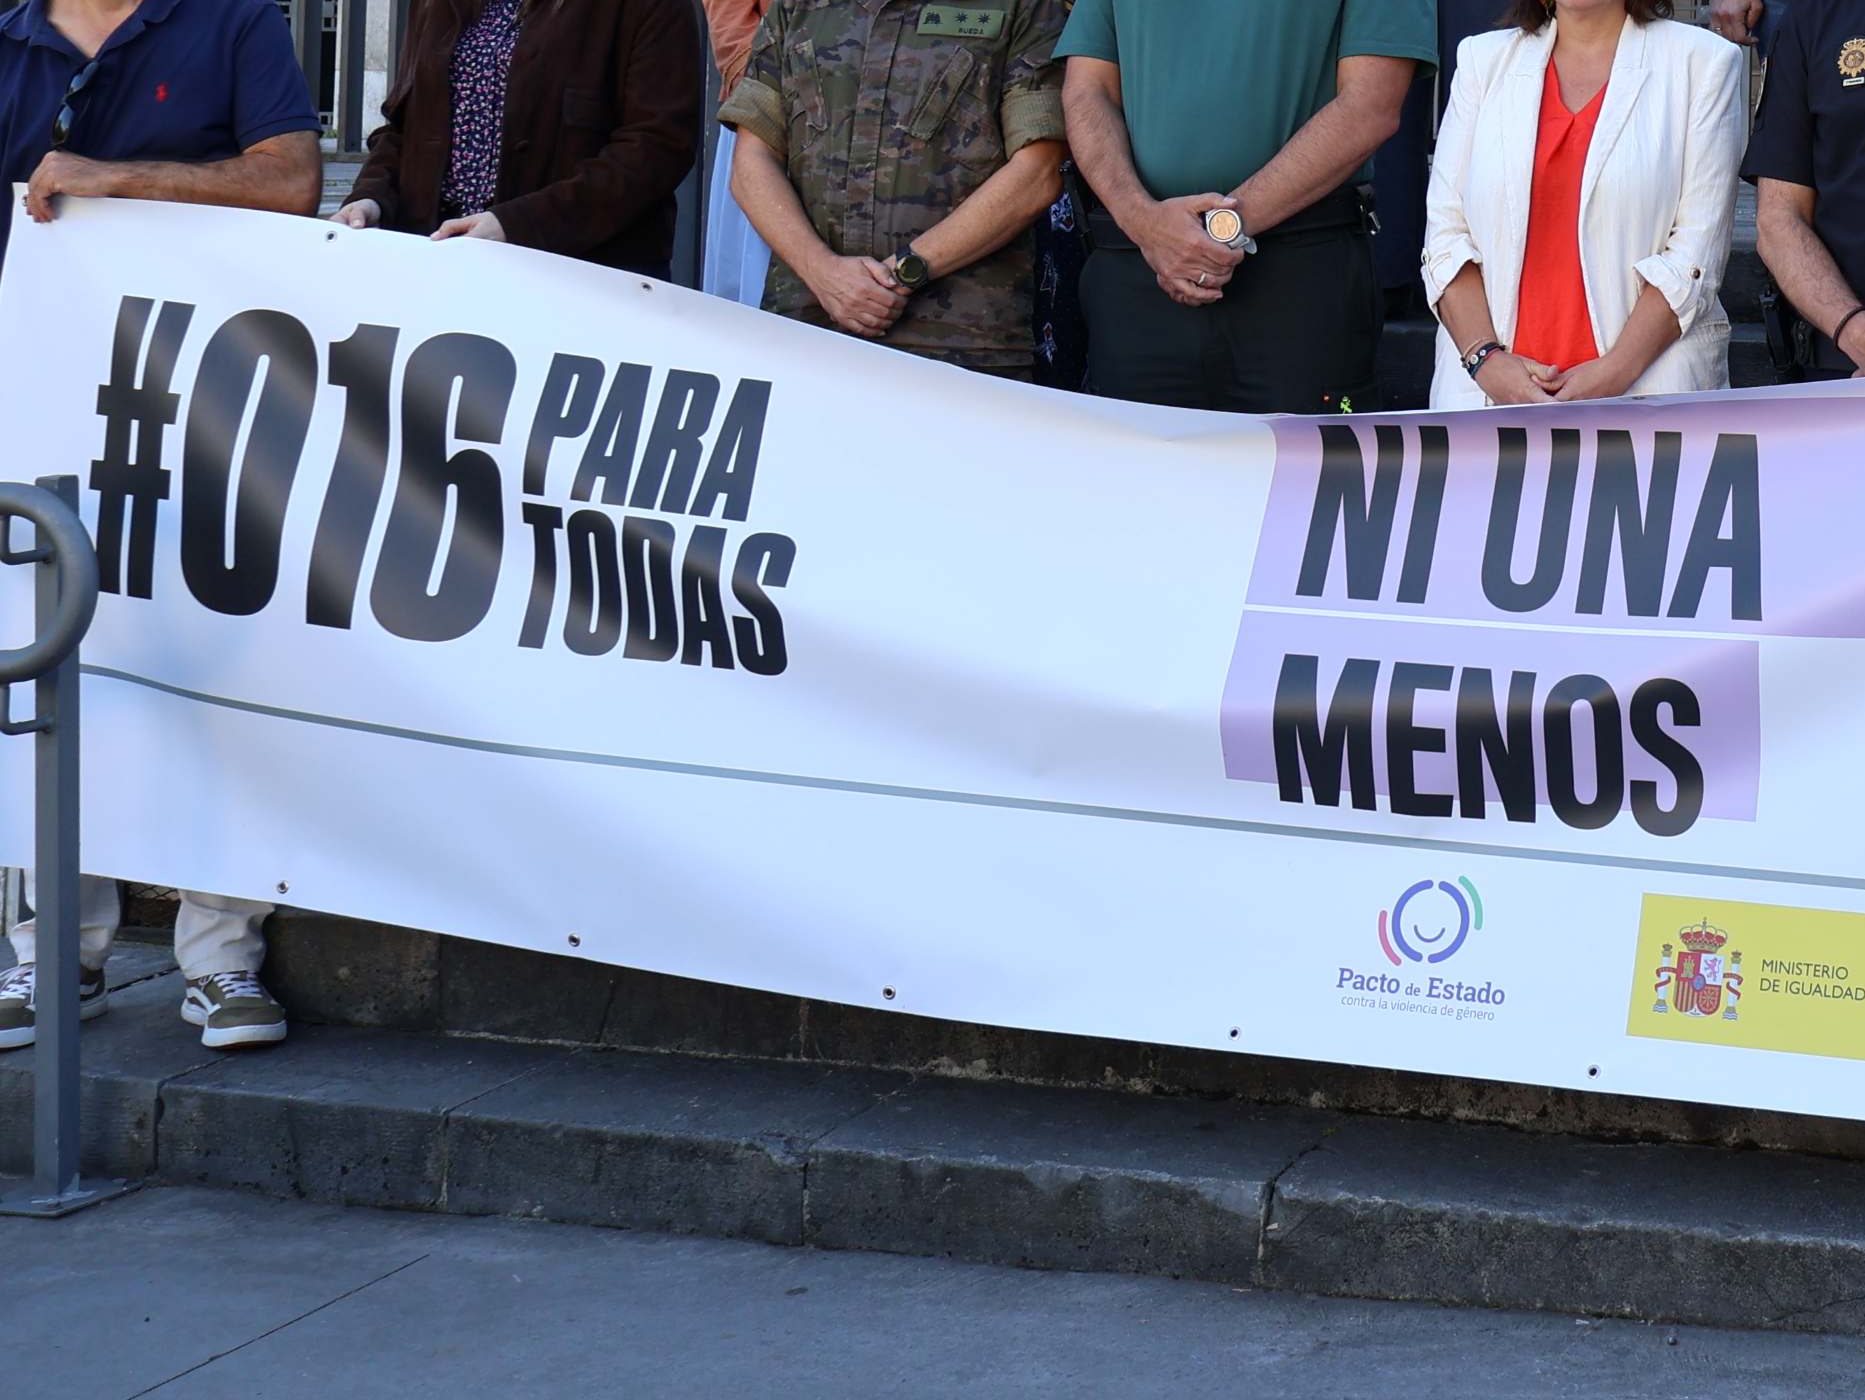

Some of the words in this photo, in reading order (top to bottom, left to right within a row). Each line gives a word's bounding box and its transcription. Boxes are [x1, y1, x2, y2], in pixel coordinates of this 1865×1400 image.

[89, 295, 517, 642] #016
[522, 352, 773, 522] PARA
[517, 501, 797, 676] TODAS
[1295, 424, 1450, 604] NI
[1481, 427, 1762, 621] UNA
[1272, 653, 1704, 837] MENOS
[1336, 968, 1400, 994] Pacto
[1405, 983, 1421, 997] de
[1426, 977, 1505, 1005] Estado
[1341, 995, 1376, 1009] contra
[1378, 998, 1388, 1010] la
[1390, 1000, 1437, 1015] violencia
[1440, 1005, 1454, 1017] de
[1759, 978, 1780, 993] DE
[1761, 959, 1849, 980] MINISTERIO
